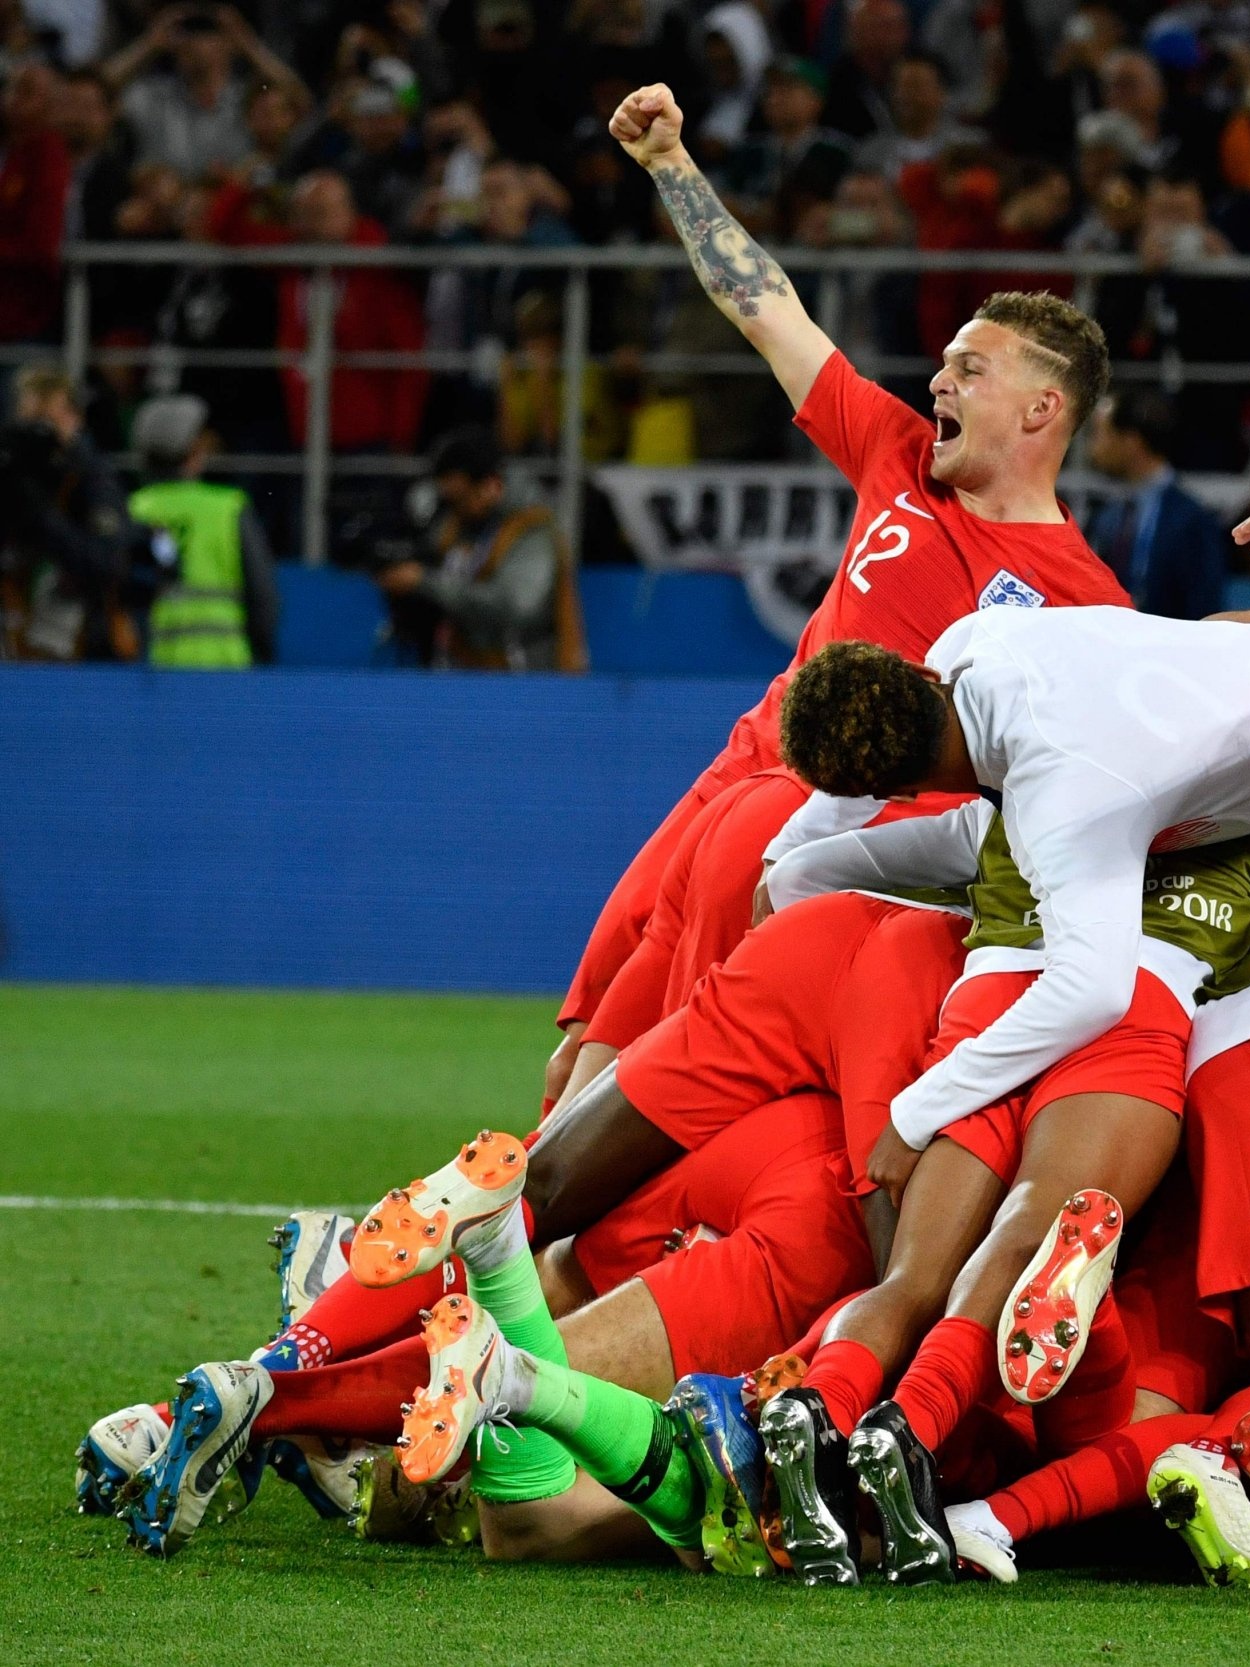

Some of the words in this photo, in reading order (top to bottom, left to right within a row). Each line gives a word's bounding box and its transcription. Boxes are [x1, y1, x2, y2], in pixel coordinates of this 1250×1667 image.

[846, 510, 911, 595] 12
[1161, 875, 1195, 889] CUP
[1158, 892, 1234, 933] 2018
